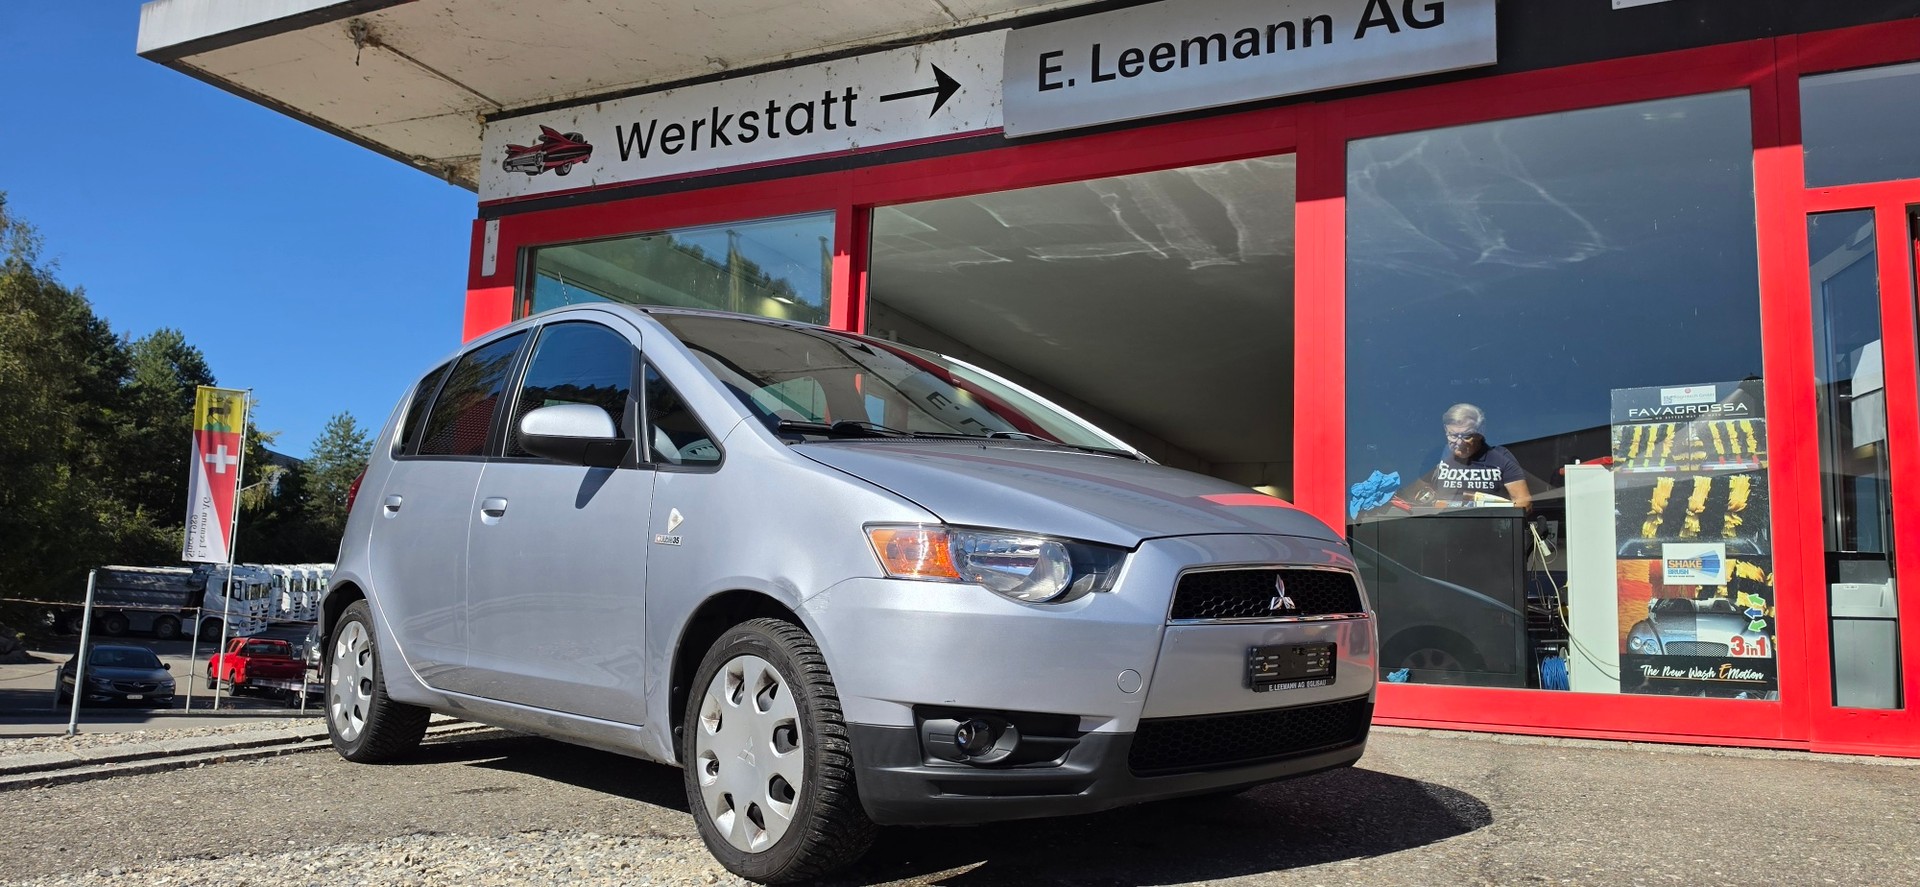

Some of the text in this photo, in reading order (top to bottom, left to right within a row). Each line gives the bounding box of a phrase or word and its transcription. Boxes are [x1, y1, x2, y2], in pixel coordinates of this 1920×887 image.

[1038, 0, 1444, 92] E. Leemann AG
[615, 87, 858, 162] Werkstatt
[1628, 402, 1748, 417] FAVAGROSSA
[1438, 468, 1502, 481] BOXEUR
[1443, 480, 1495, 489] DES RUES
[1667, 559, 1703, 569] SHAKE
[1640, 664, 1660, 677] The
[1661, 665, 1686, 677] New
[1688, 666, 1717, 680] Wash
[1274, 682, 1297, 691] LEEMANN
